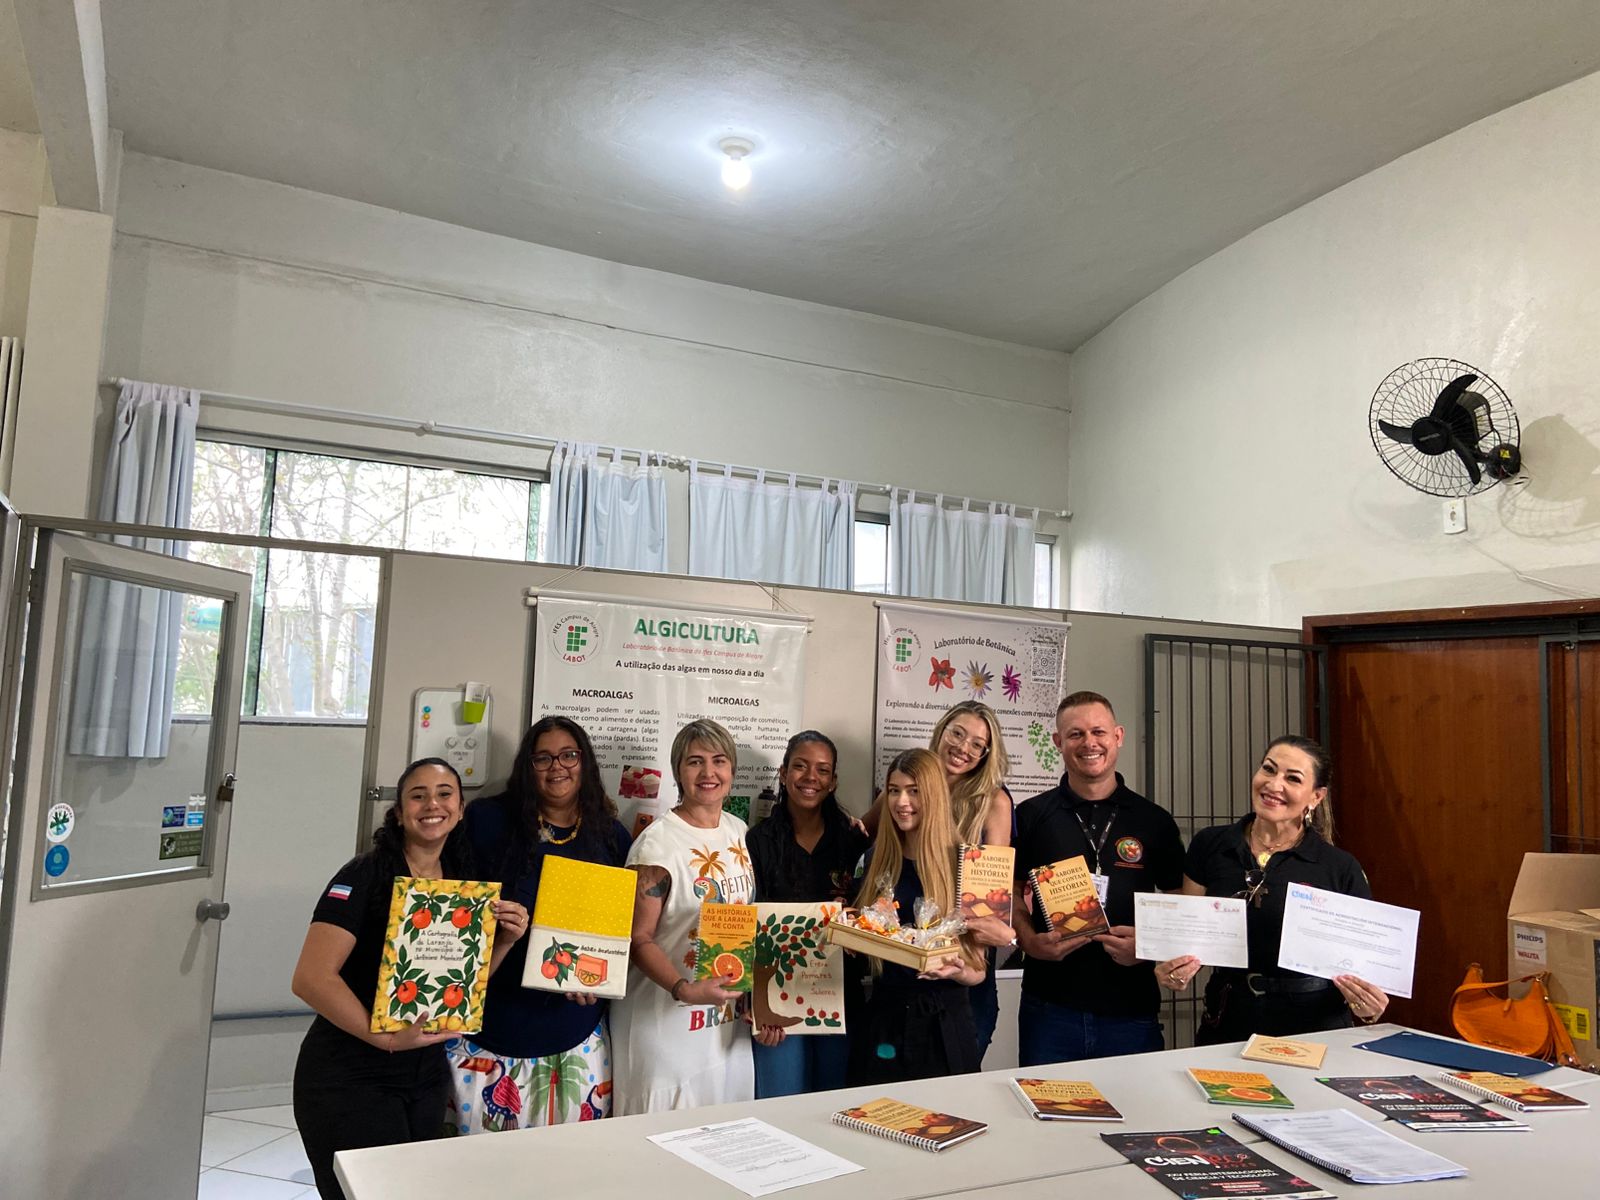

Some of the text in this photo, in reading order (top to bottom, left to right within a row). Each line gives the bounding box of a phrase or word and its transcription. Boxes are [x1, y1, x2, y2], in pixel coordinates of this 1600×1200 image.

[634, 618, 760, 645] ALGICULTURA
[934, 636, 976, 650] Laboratório
[976, 637, 985, 646] de
[985, 638, 1016, 656] Botânica
[562, 653, 586, 663] LABOT
[714, 650, 736, 659] Campus
[616, 660, 622, 668] A
[624, 660, 661, 671] utilização
[662, 664, 676, 672] das
[677, 664, 697, 674] algas
[712, 668, 733, 676] nosso
[734, 668, 746, 677] dia
[754, 670, 765, 678] dia
[572, 688, 633, 700] MACROALGAS
[708, 696, 760, 707] MICROALGAS
[886, 700, 921, 709] Explorando
[925, 702, 953, 711] diversida
[555, 704, 591, 714] macroalgas
[596, 706, 620, 714] podem
[640, 708, 660, 716] usadas
[996, 708, 1020, 717] conexões
[600, 716, 629, 724] alimento
[715, 715, 749, 723] composição
[758, 717, 790, 725] cosméticos,
[607, 726, 638, 734] carragena
[641, 726, 659, 735] (algas
[728, 724, 752, 732] nutrição
[631, 744, 658, 752] indústria
[982, 856, 1010, 864] SABORES
[986, 862, 1010, 870] CONTAM
[970, 869, 1009, 879] HISTÓRIAS
[1056, 866, 1083, 878] SABORES
[1062, 872, 1087, 883] CONTAM
[1048, 880, 1089, 896] HISTÓRIAS
[716, 908, 751, 917] HISTÓRIAS
[724, 916, 754, 924] LARANJA
[723, 922, 745, 930] CONTA
[1516, 934, 1544, 944] PHILIPS
[1517, 950, 1540, 960] WALITA
[688, 1004, 734, 1031] BRA
